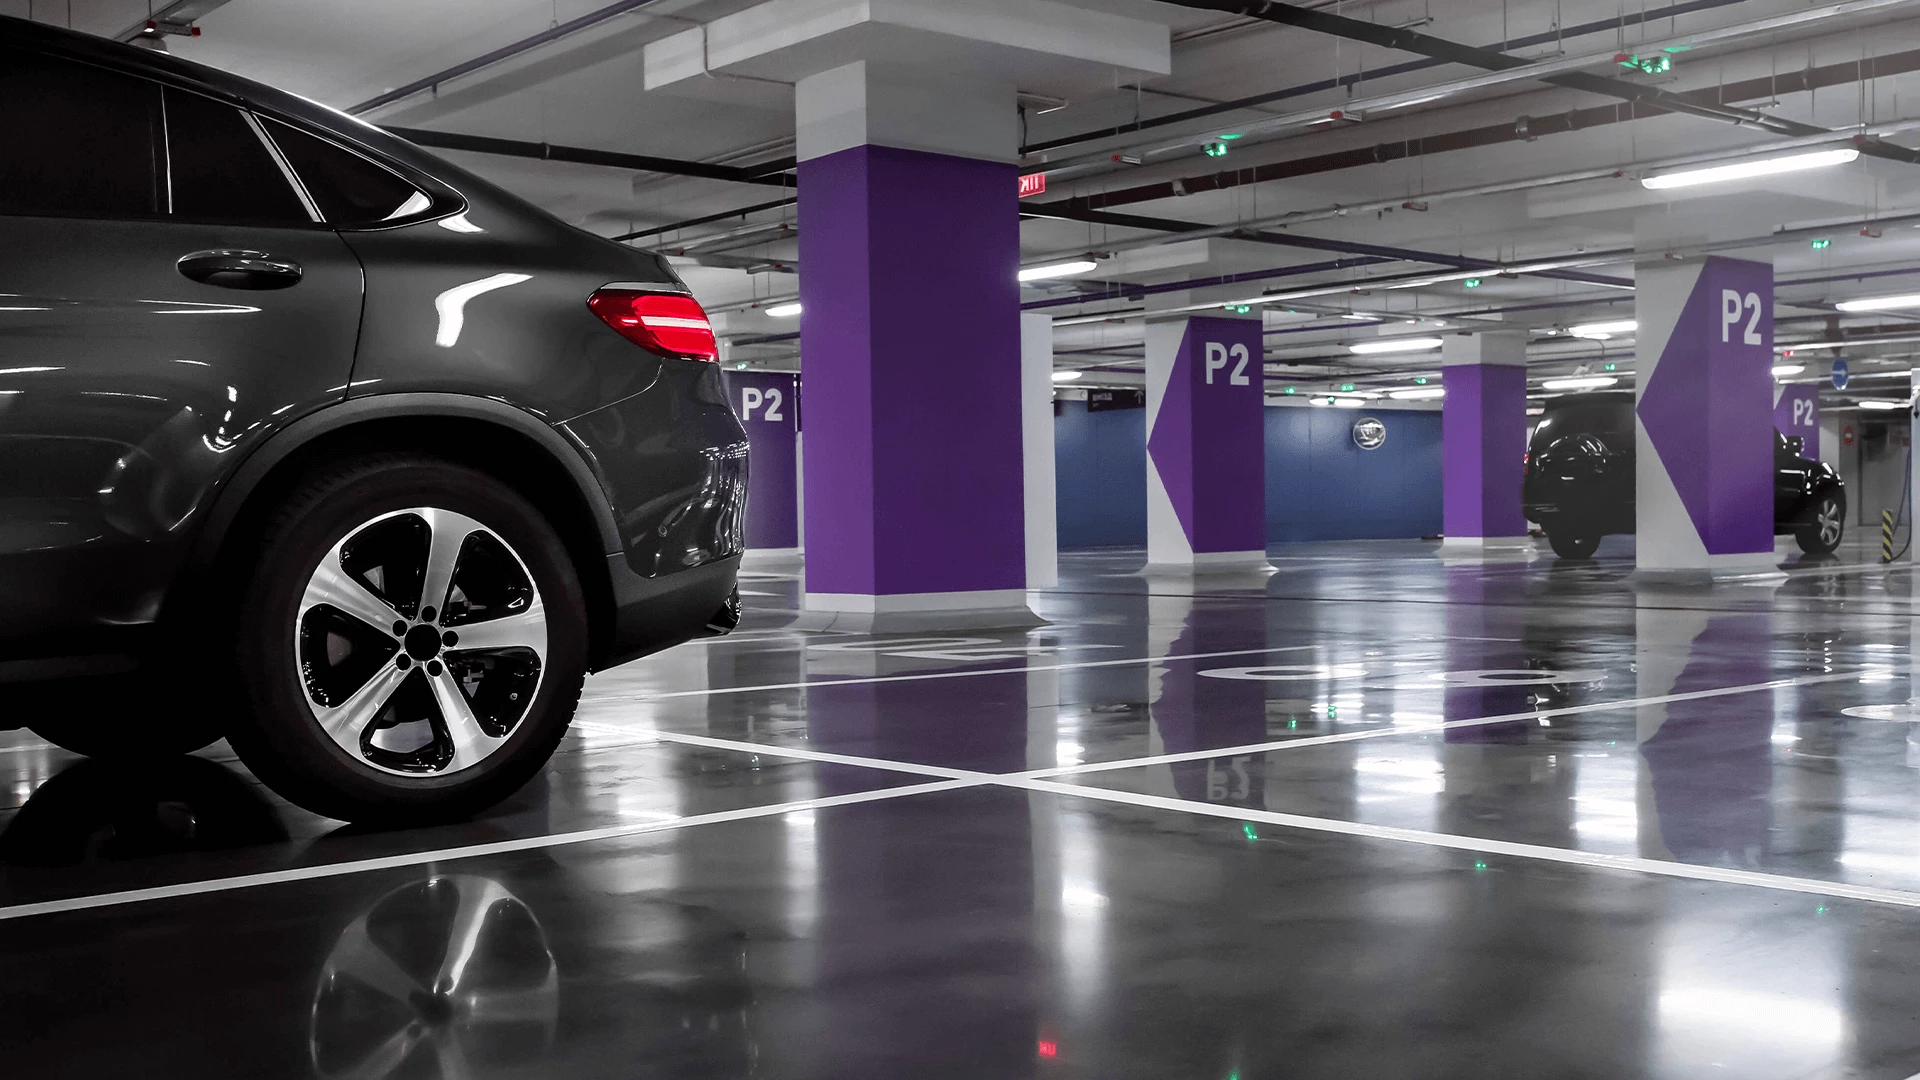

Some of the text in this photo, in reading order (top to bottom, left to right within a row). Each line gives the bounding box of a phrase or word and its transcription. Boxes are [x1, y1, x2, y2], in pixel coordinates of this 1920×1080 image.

[1721, 288, 1762, 345] P2
[1205, 341, 1250, 386] P2
[742, 386, 783, 422] P2
[1793, 398, 1814, 426] P2
